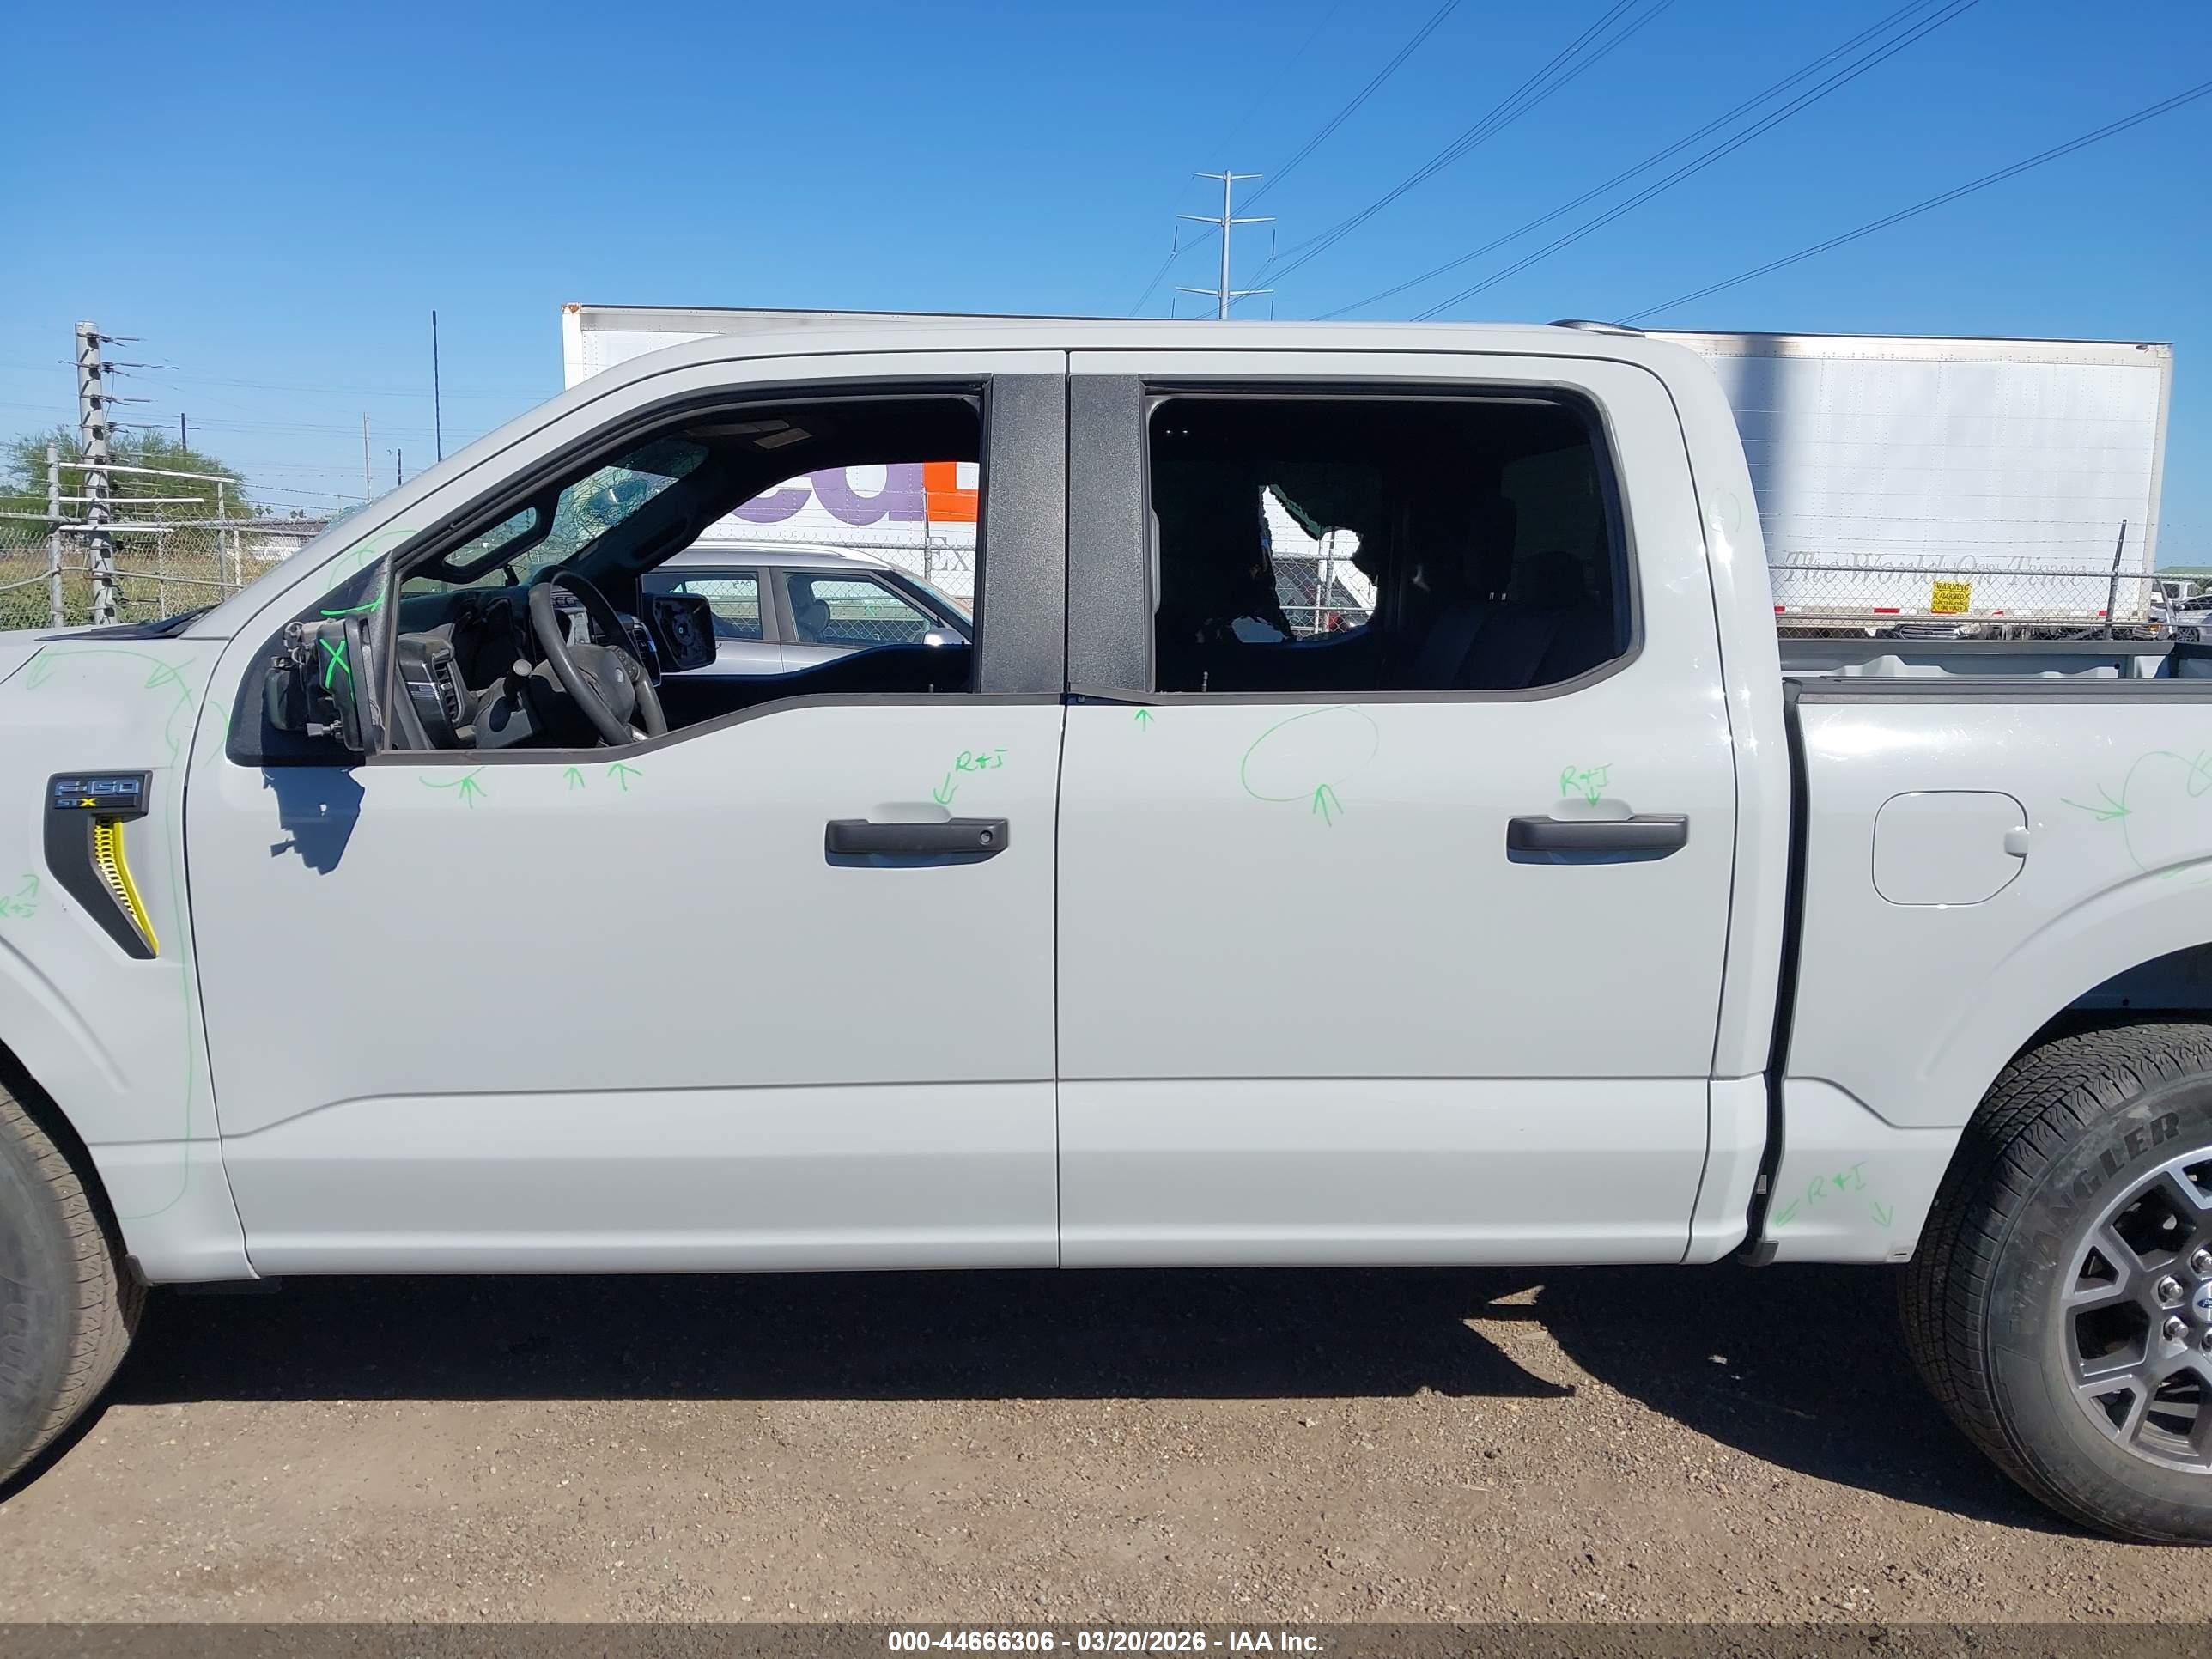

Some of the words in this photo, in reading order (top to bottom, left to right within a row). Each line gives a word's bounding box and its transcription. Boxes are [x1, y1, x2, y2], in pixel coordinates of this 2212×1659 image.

[1784, 551, 1839, 583] The
[1850, 553, 1946, 586] World
[1954, 555, 1994, 586] On
[2007, 556, 2087, 586] Time
[1936, 582, 1971, 592] WARNING
[55, 780, 139, 797] F-150
[56, 798, 97, 807] STX
